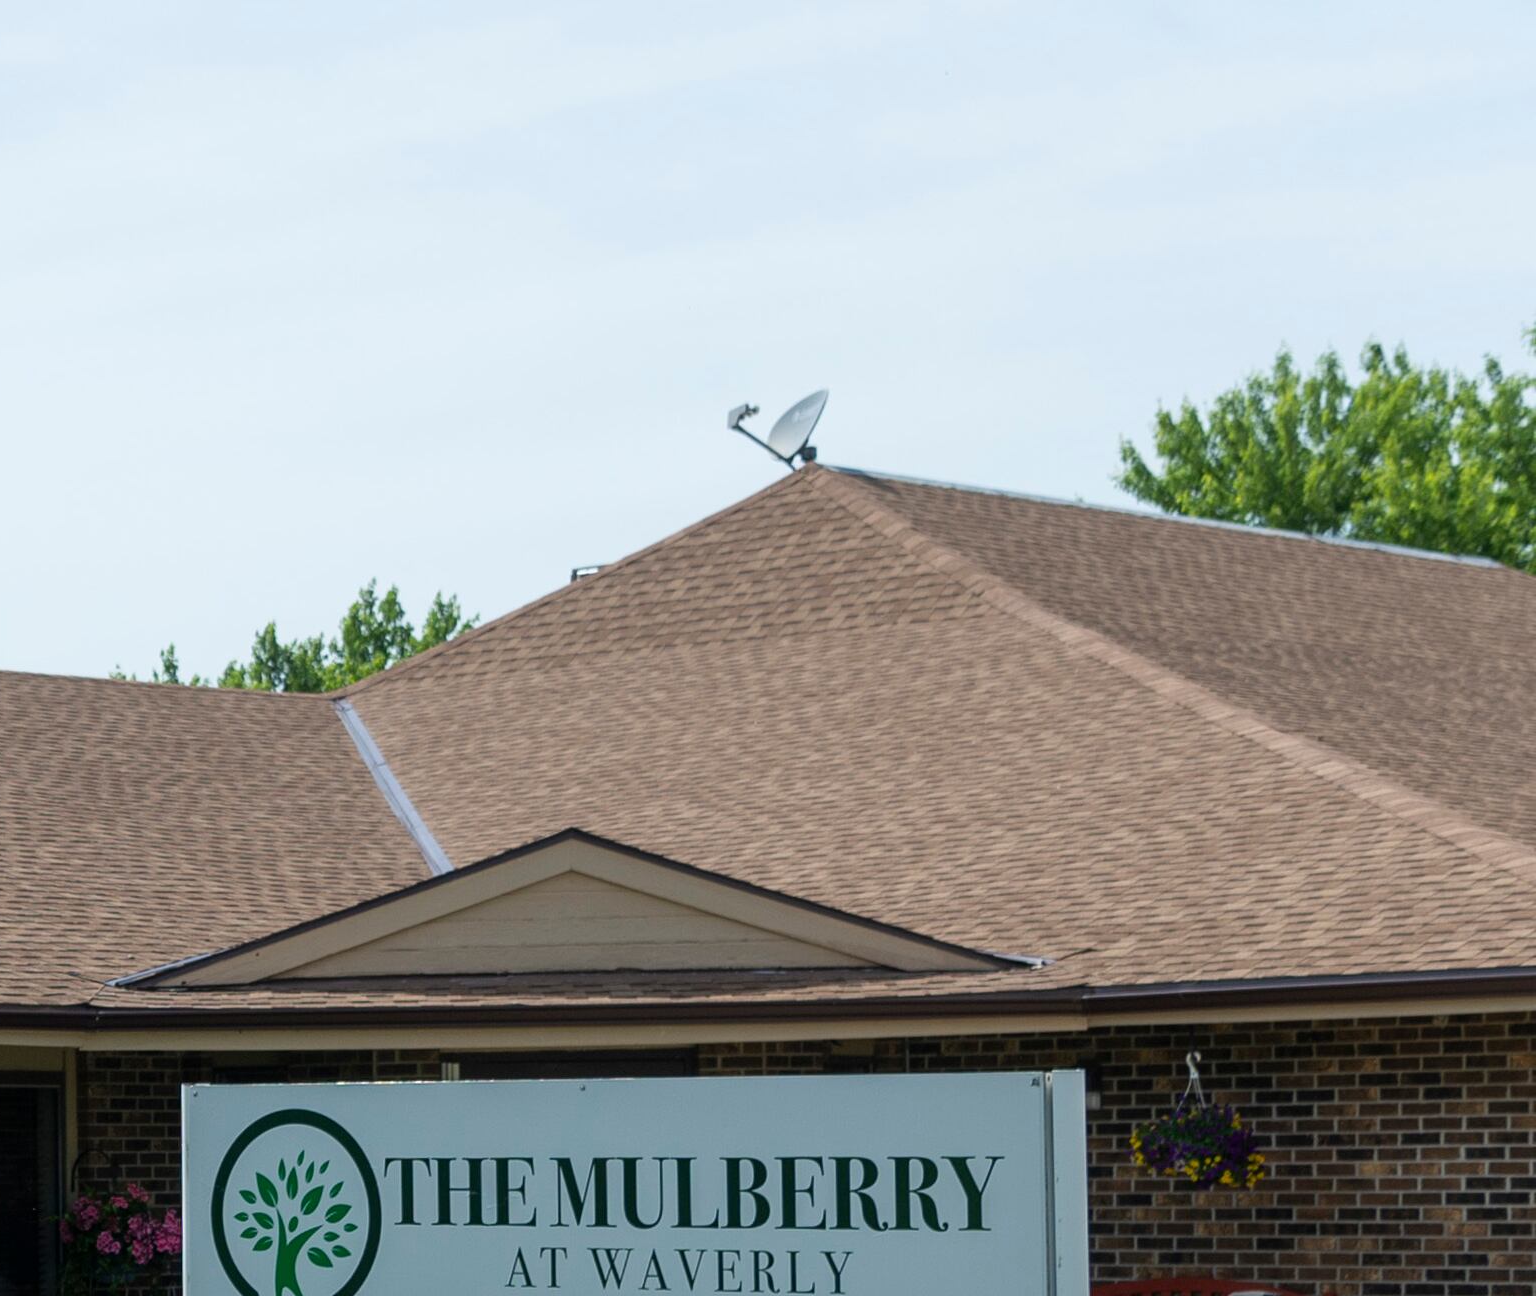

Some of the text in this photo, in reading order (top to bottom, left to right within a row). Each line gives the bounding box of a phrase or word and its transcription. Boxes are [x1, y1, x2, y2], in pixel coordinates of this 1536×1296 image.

[384, 1155, 1005, 1233] THE MULBERRY
[504, 1245, 855, 1296] AT WAVERLY
